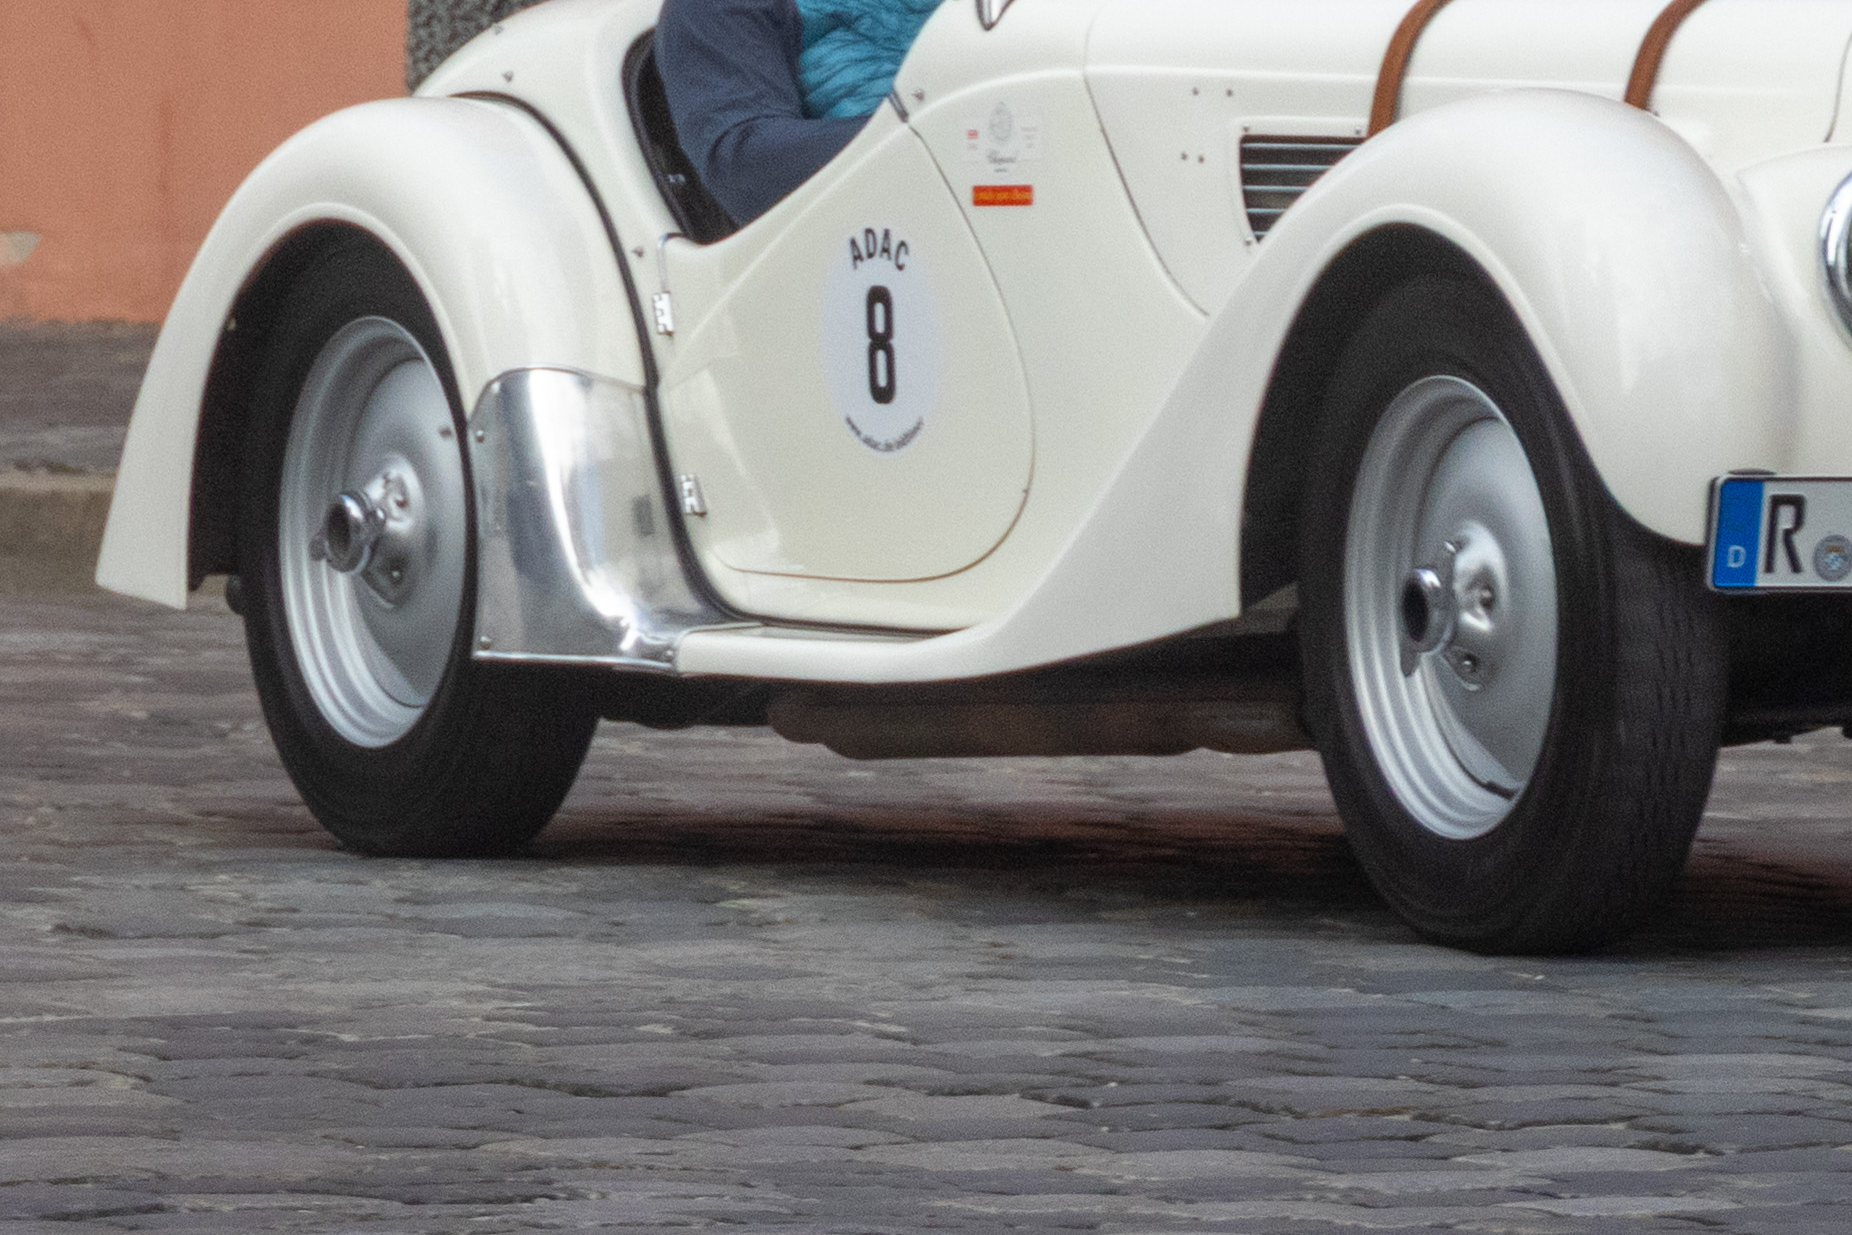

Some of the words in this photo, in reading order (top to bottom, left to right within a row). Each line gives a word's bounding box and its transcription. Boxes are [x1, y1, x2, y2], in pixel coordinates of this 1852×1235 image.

[849, 227, 909, 271] ADAC
[866, 285, 896, 404] 8
[1727, 545, 1746, 568] D
[1763, 493, 1807, 575] R
